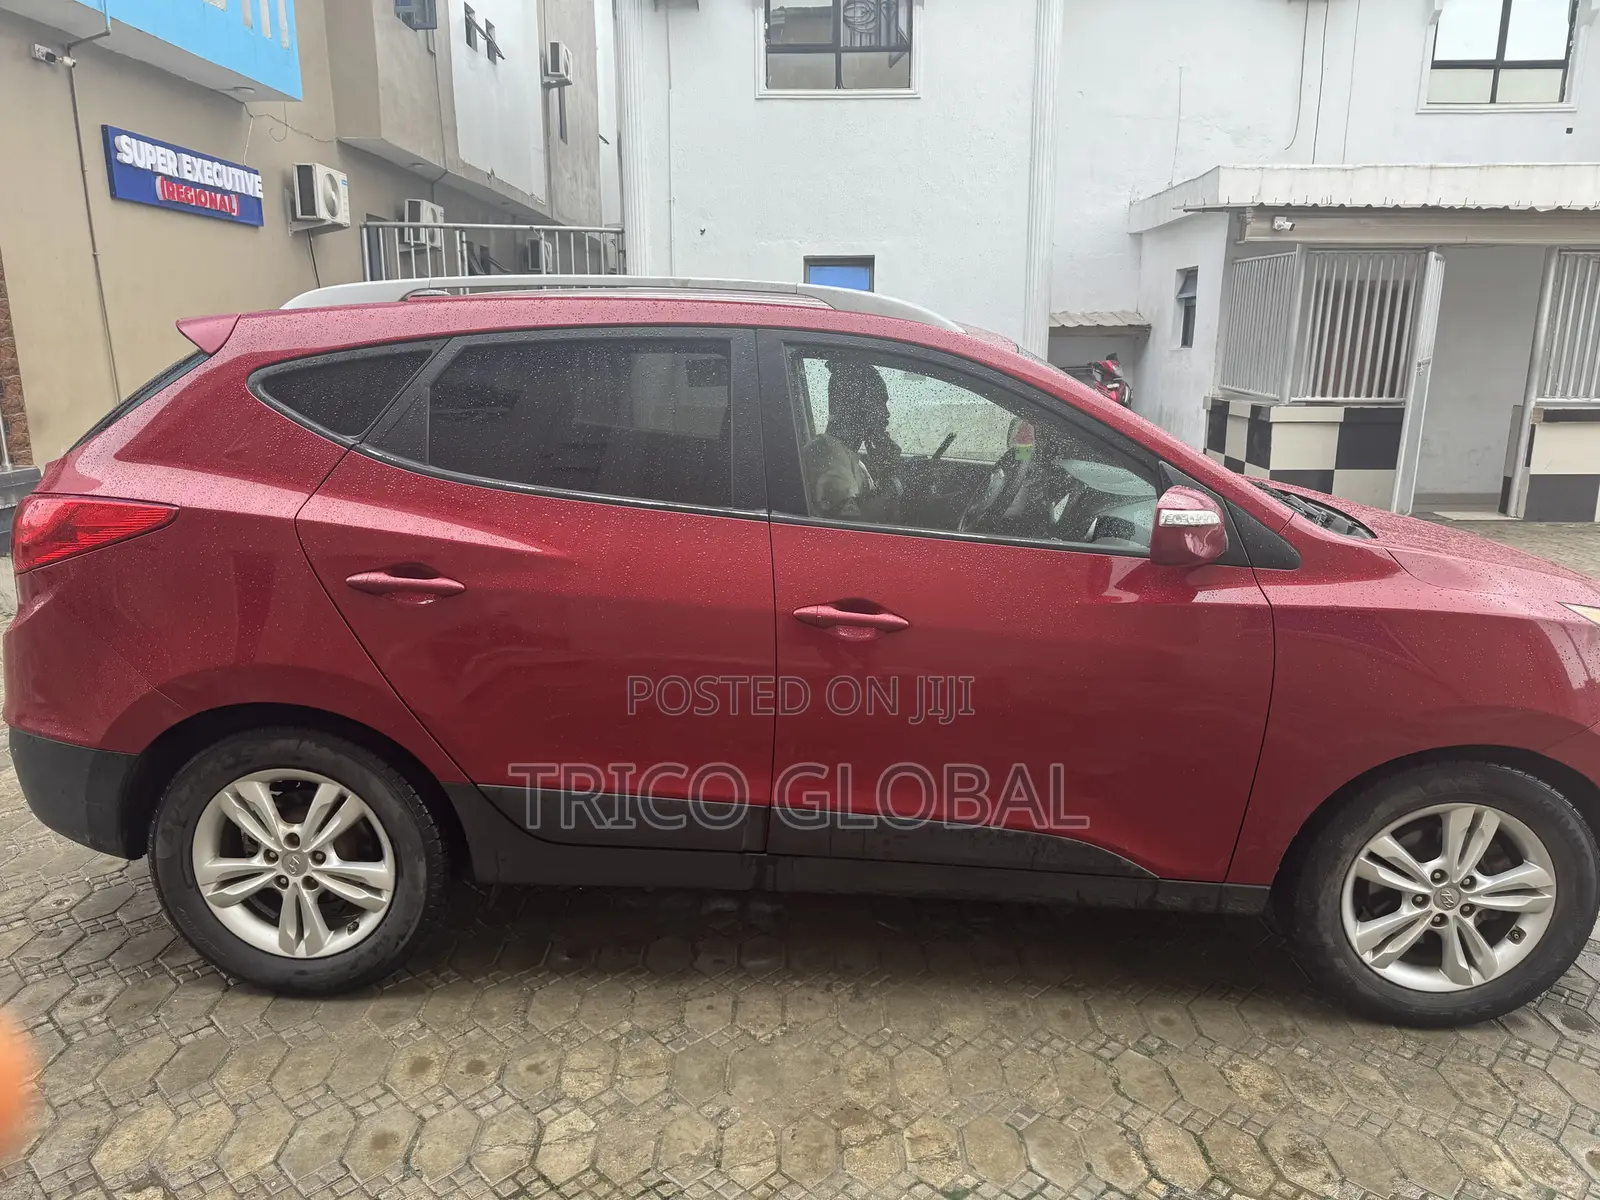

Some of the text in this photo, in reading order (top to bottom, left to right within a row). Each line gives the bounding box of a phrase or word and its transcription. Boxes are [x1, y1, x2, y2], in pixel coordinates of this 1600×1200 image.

[114, 134, 263, 199] SUPER EXECUTIVE
[156, 175, 240, 216] (REGIONAL)
